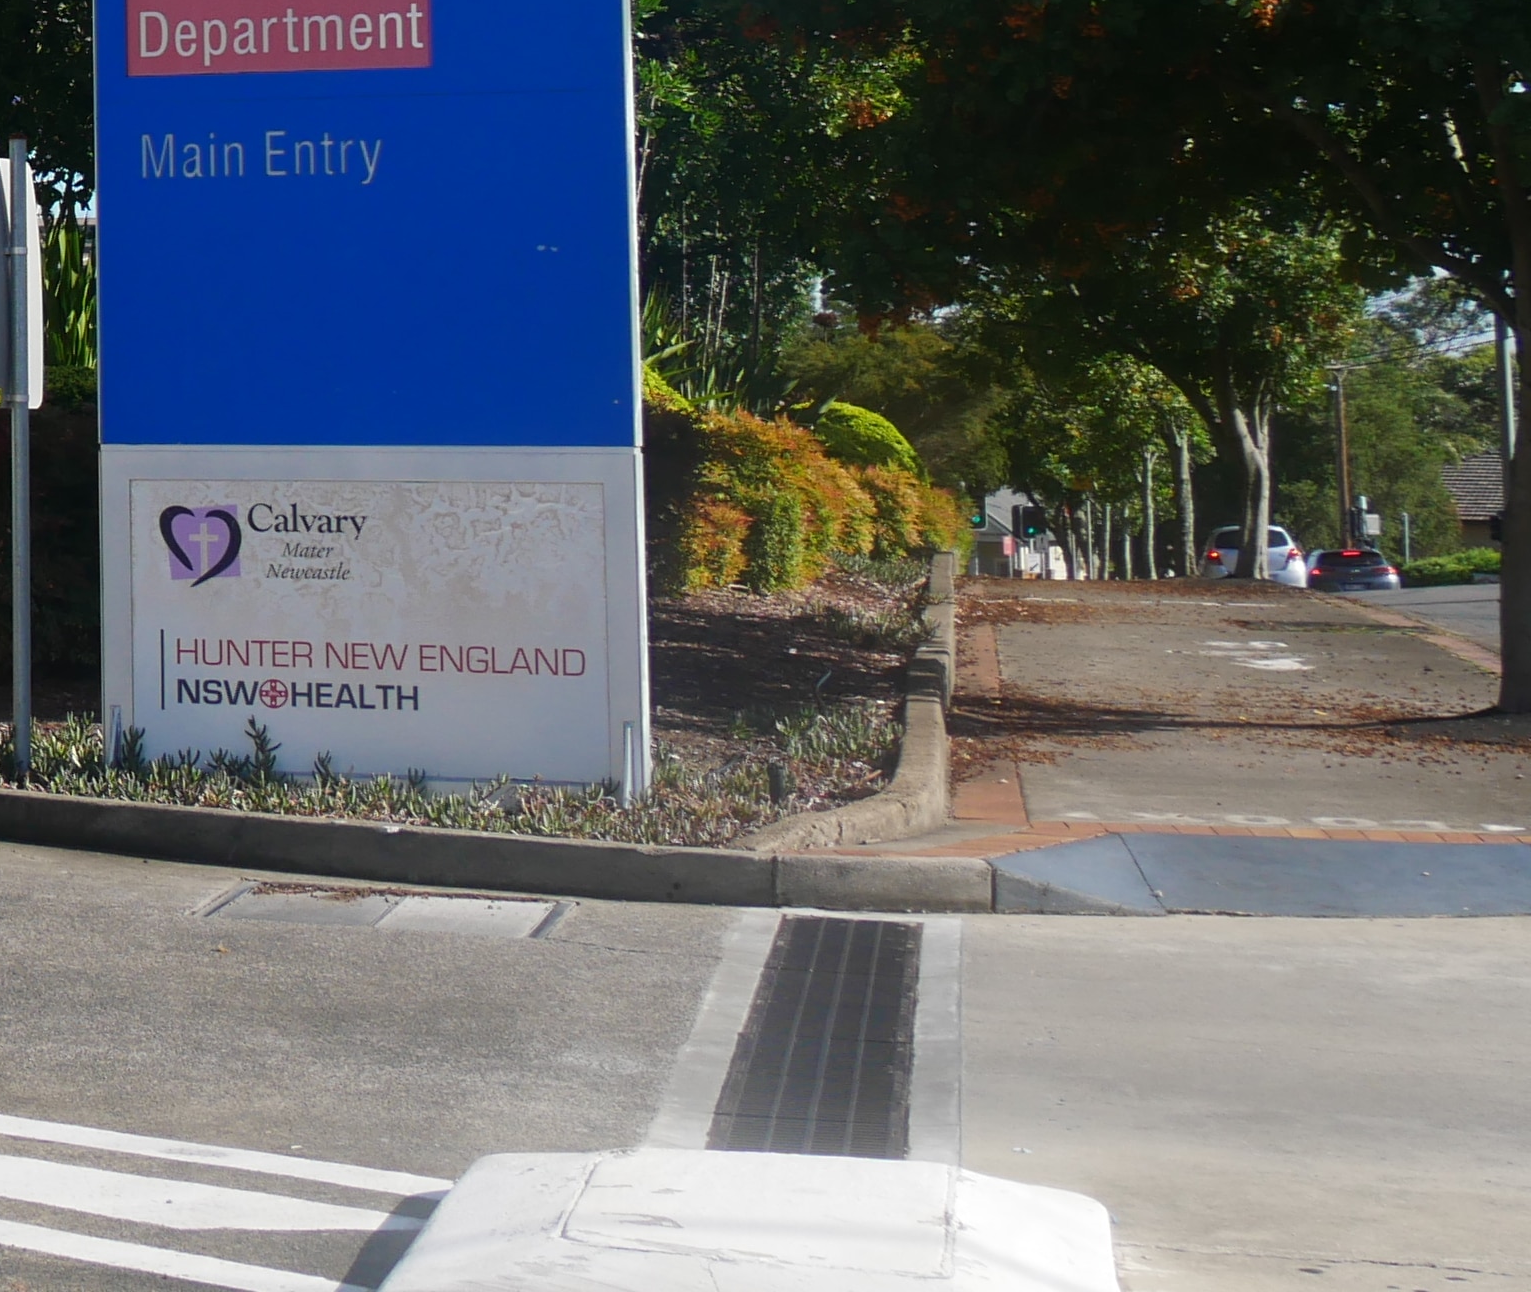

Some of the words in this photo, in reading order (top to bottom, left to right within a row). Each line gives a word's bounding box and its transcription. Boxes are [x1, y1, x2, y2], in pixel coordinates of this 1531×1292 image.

[139, 3, 424, 66] Department
[141, 133, 245, 179] Main
[264, 130, 383, 185] Entry
[247, 502, 368, 540] Calvary
[281, 542, 335, 558] Mater
[265, 561, 351, 580] Newcastle
[175, 638, 314, 669] HUNTER
[324, 641, 409, 672] NEW
[418, 644, 587, 677] ENGLAND
[176, 677, 259, 705] NSW
[290, 681, 420, 710] HEALTH
